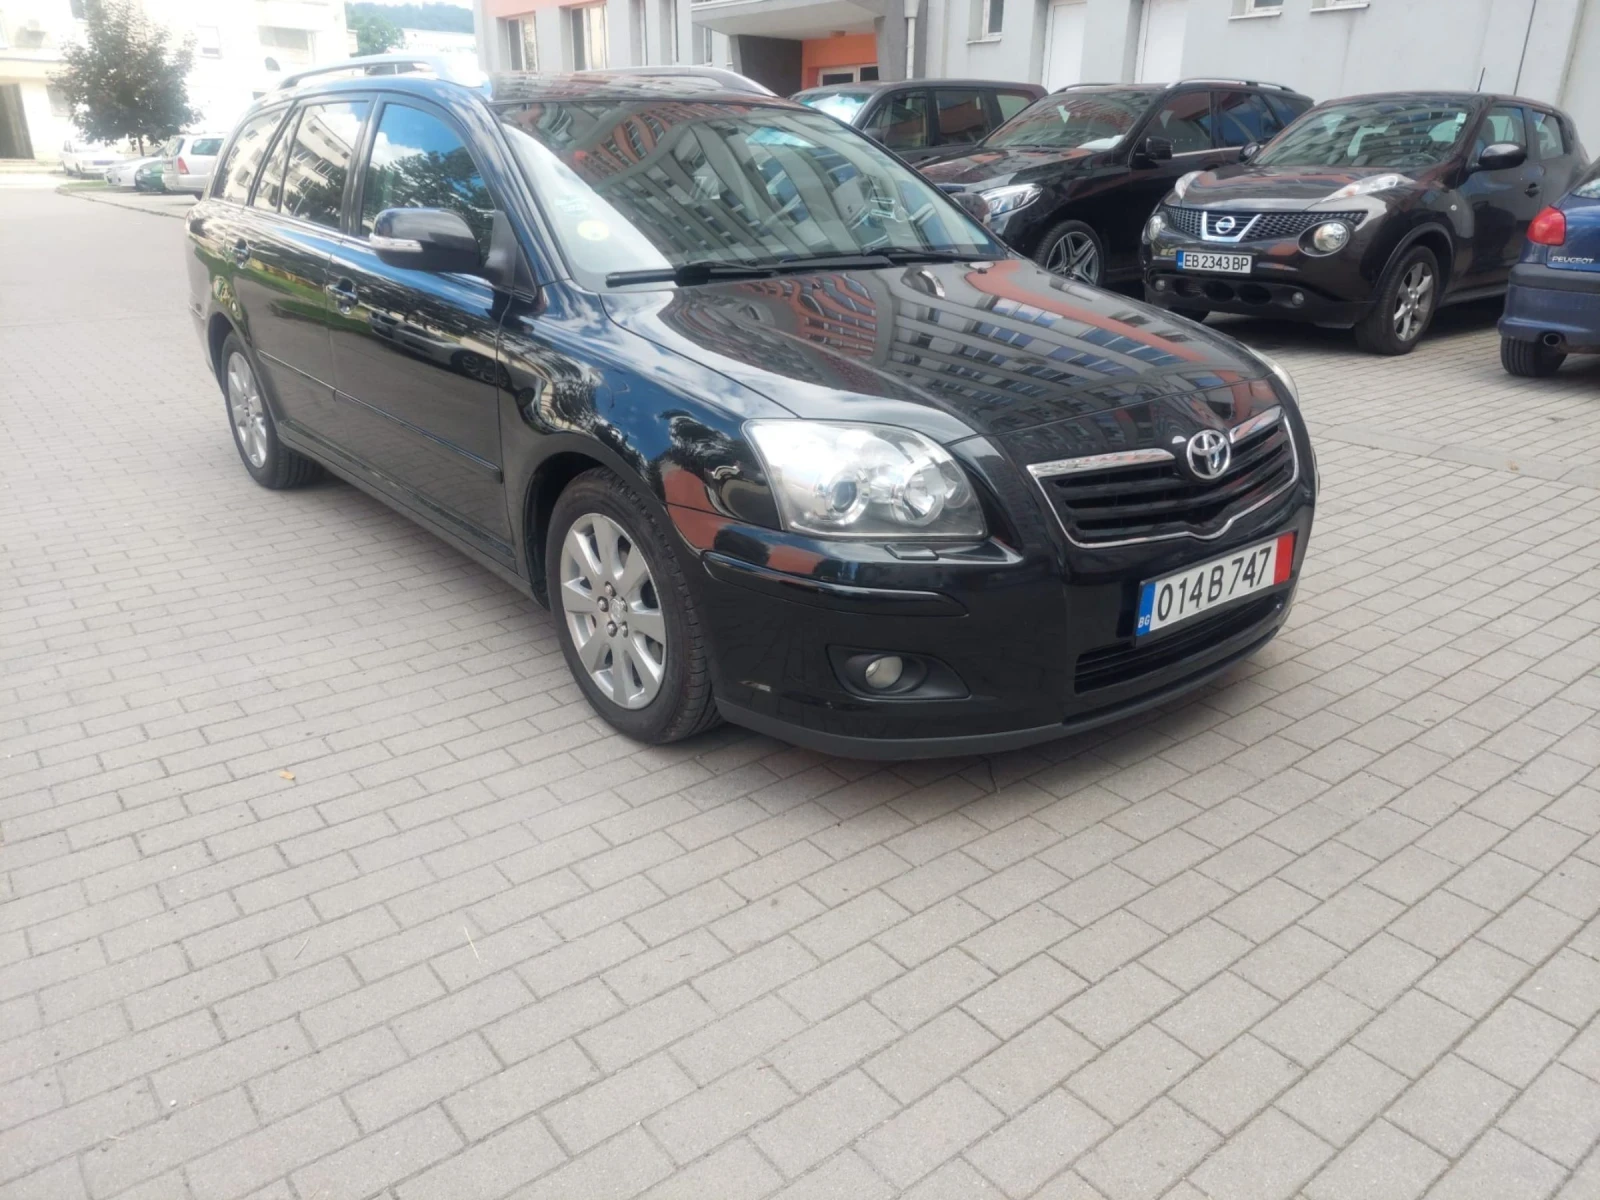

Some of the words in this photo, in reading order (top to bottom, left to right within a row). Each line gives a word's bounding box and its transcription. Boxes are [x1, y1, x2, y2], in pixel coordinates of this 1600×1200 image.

[1184, 254, 1199, 268] EB
[1201, 255, 1230, 270] 2343
[1232, 257, 1249, 271] BP
[1552, 256, 1594, 264] PEUGEOT
[1138, 615, 1150, 629] BG
